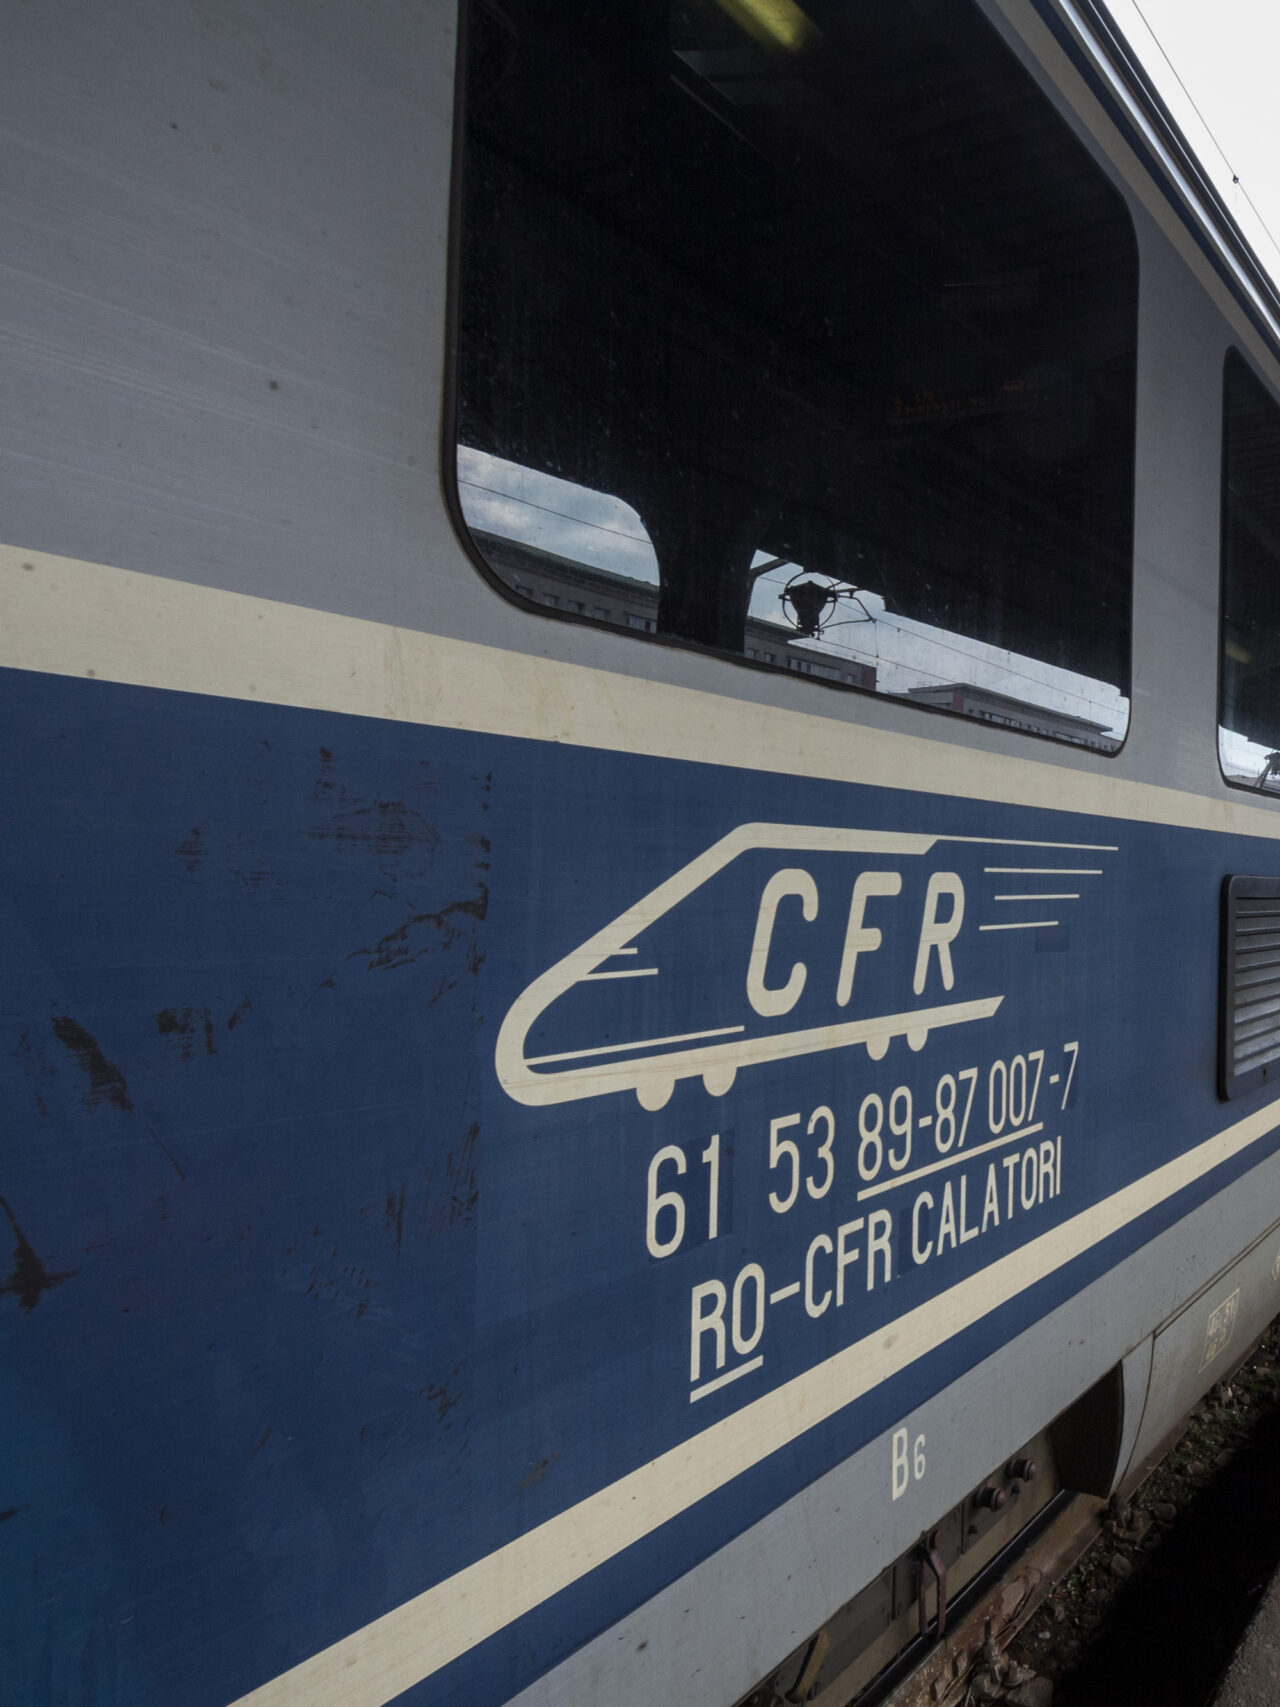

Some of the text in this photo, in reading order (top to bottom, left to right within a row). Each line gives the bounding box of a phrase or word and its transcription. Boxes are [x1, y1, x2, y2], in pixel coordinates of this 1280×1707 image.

[746, 868, 966, 1017] CFR
[646, 1040, 1079, 1259] 61 53 89-87 007-7
[690, 1135, 1062, 1383] RO-CFR CALATORI
